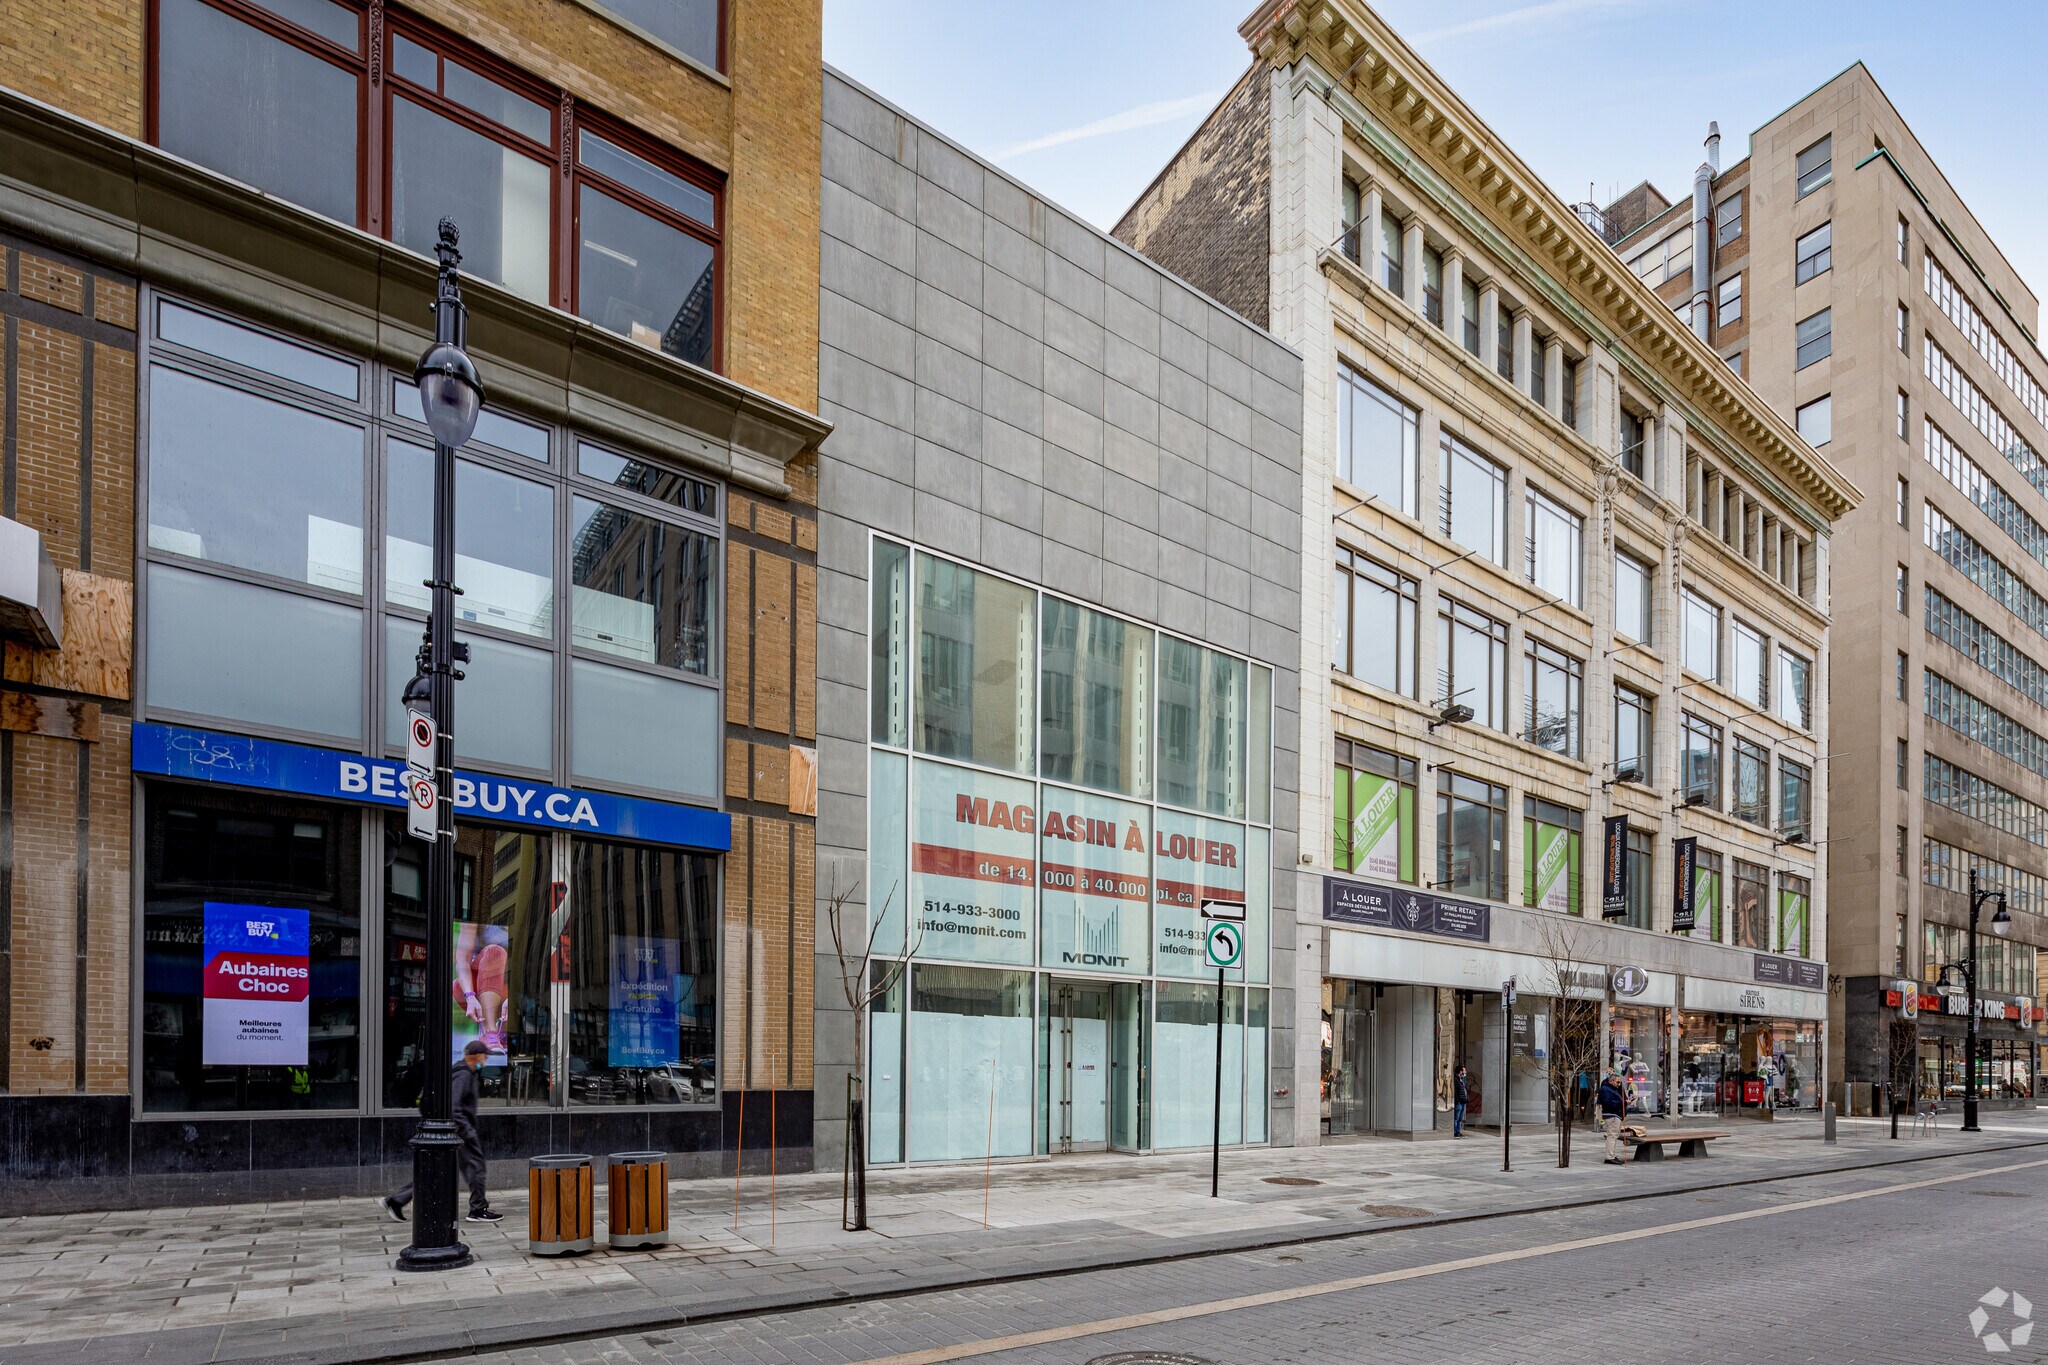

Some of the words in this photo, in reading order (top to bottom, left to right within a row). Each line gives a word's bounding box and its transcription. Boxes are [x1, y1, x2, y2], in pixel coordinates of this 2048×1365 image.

[1361, 786, 1396, 832] LOUER
[1124, 819, 1145, 853] À
[1156, 831, 1237, 868] LOUER
[1542, 834, 1567, 871] LOUER
[979, 861, 1000, 877] de
[1080, 875, 1090, 889] à
[1094, 878, 1146, 897] 40.000
[1156, 887, 1173, 903] pi.
[1177, 892, 1196, 904] ca.
[1342, 890, 1349, 901] À
[1351, 894, 1382, 906] LOUER
[924, 900, 1020, 921] 514-933-3000
[1440, 903, 1457, 913] PRIME
[1458, 906, 1477, 915] RETAIL
[246, 921, 275, 930] BEST
[248, 929, 272, 937] BUY
[917, 918, 1027, 940] info@monit.com
[1062, 951, 1129, 967] MONIT
[1765, 962, 1778, 970] LOUER
[219, 960, 308, 978] Aubaines
[238, 978, 290, 993] Choc
[621, 981, 668, 992] Expédition
[625, 1004, 663, 1014] Gratuite.
[1740, 995, 1765, 1009] SIRENS
[1984, 999, 2005, 1020] KING
[239, 1019, 282, 1027] Meilleures
[621, 1046, 665, 1056] BestBuy.ca
